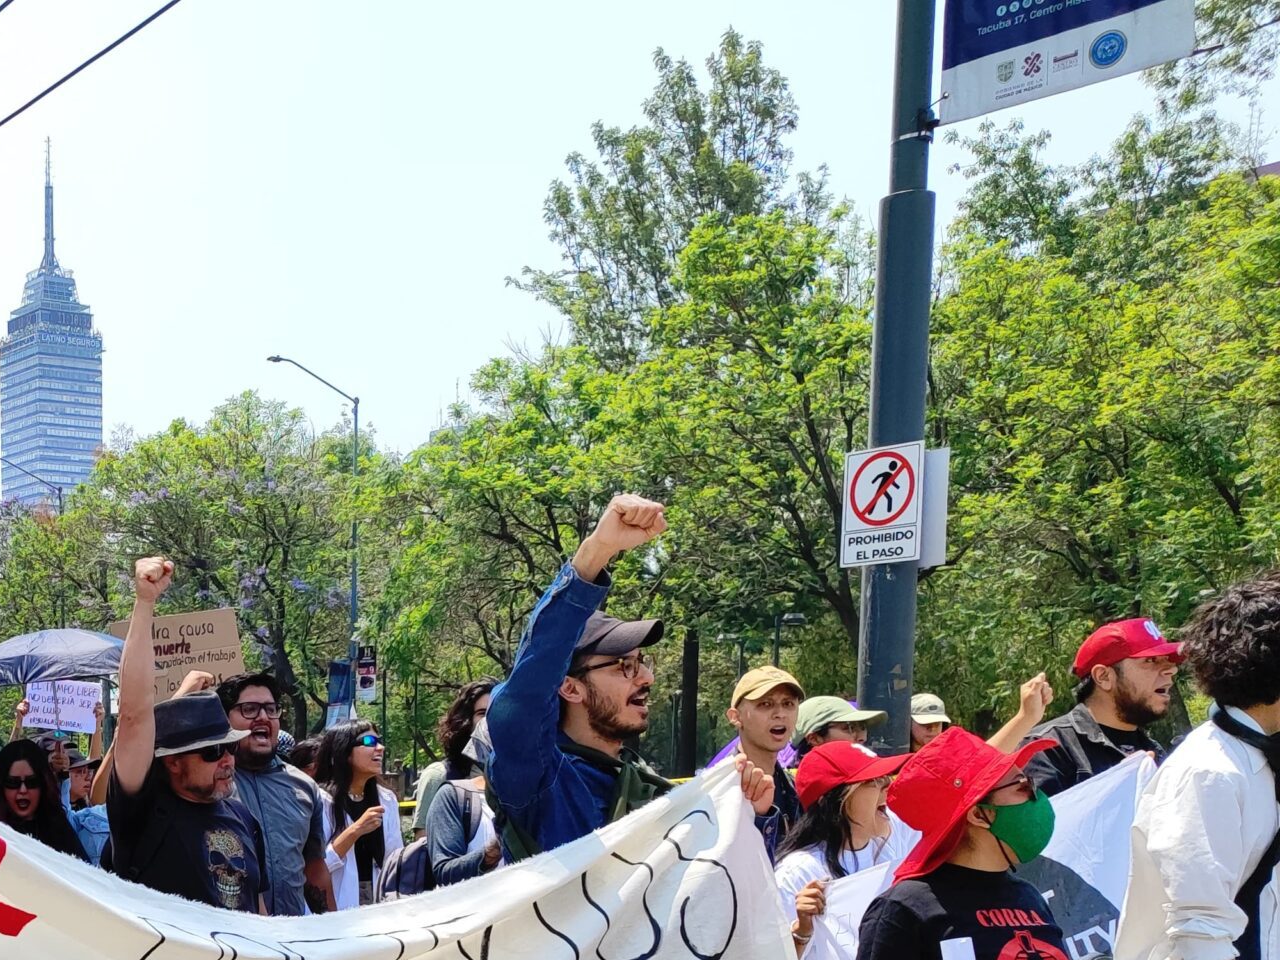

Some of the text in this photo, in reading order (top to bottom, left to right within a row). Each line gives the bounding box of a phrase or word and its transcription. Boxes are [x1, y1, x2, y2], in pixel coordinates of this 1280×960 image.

[977, 18, 1011, 36] Tacuba
[1029, 3, 1063, 19] Centro
[848, 530, 914, 547] PROHIBIDO
[856, 546, 904, 560] EL PASO
[179, 622, 215, 639] causa
[206, 649, 237, 663] trabajo
[28, 693, 41, 702] NO
[976, 908, 1049, 928] COBRA
